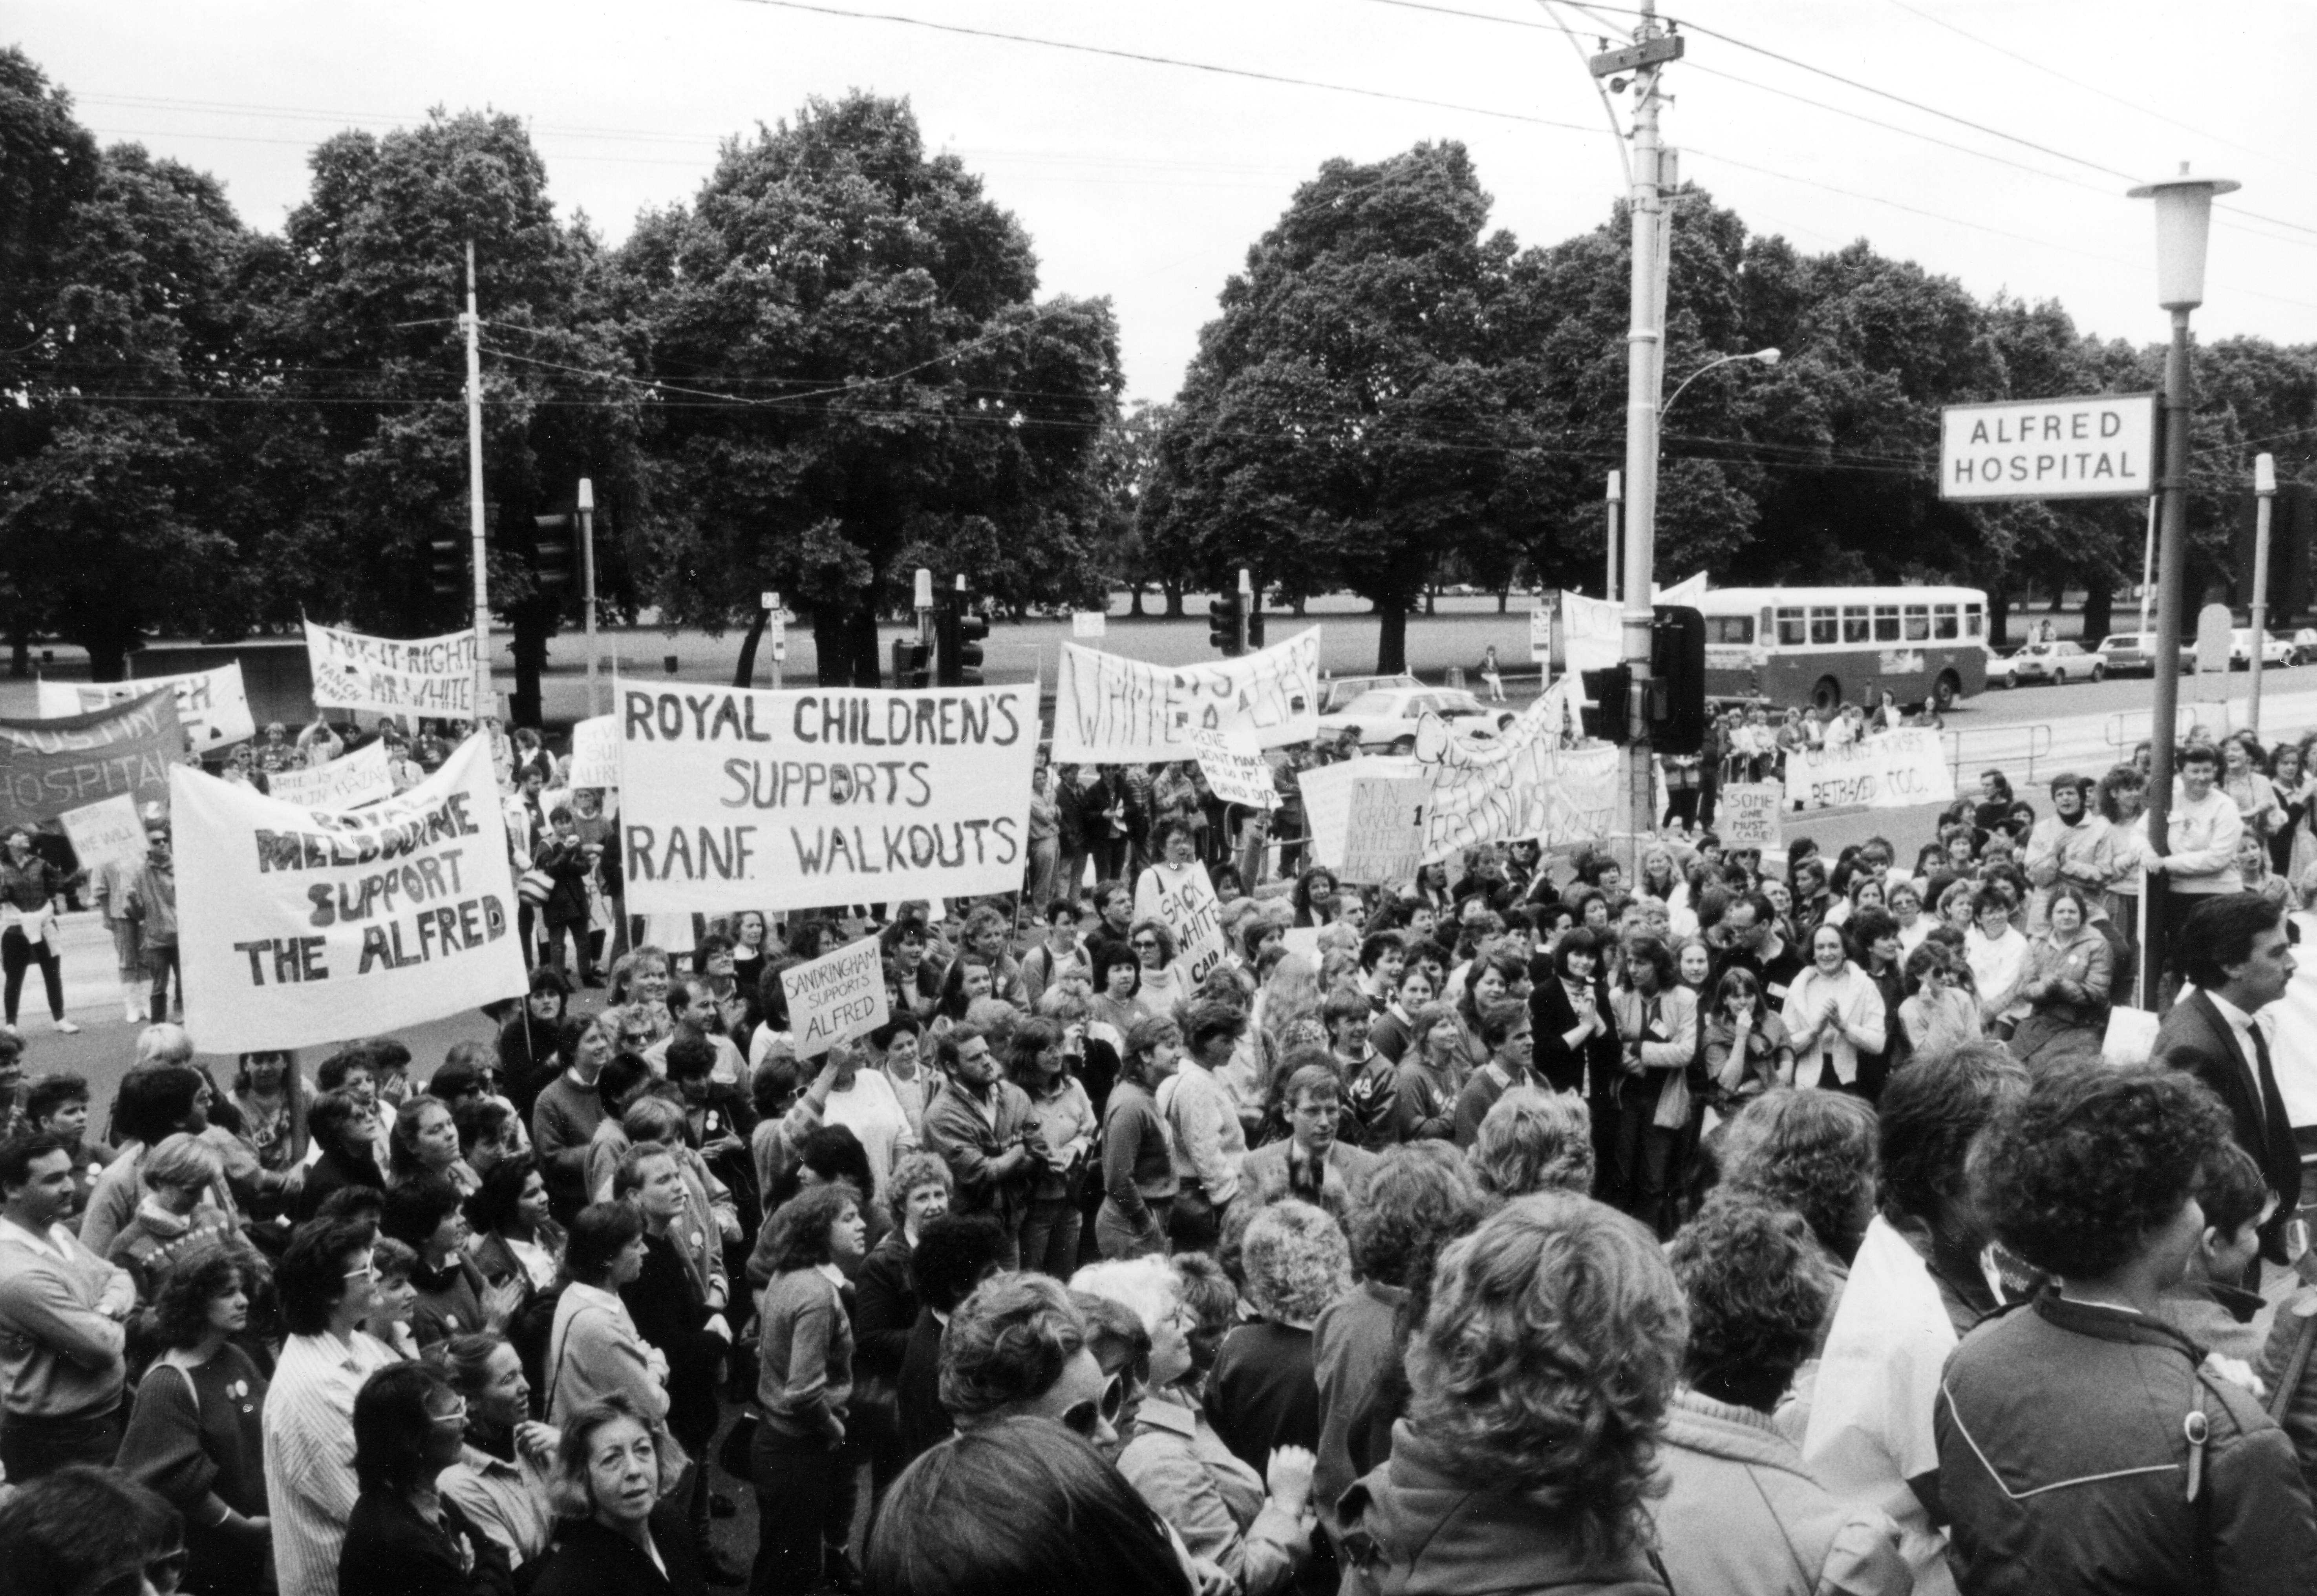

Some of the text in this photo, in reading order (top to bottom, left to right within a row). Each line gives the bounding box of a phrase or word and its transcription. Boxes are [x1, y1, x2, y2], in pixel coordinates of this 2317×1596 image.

[1970, 411, 2121, 444] ALFRED
[1955, 451, 2136, 483] HOSPITAL
[403, 676, 470, 711] WHITE
[626, 692, 1020, 745] ROYAL CHILDREN'S
[720, 758, 931, 809] SUPPORTS
[1731, 794, 1774, 809] SOME
[1811, 775, 1877, 806] BETRAYED
[1413, 804, 1423, 827] 1
[1733, 820, 1768, 831] MUST
[790, 816, 1018, 875] WALKOUTS
[308, 849, 464, 927] SUPPORT
[1161, 875, 1204, 926] SACK
[234, 895, 507, 986] THE ALFRED
[1177, 897, 1220, 955] WHITE
[785, 947, 877, 1000] SANDRINGHAM
[808, 975, 870, 1010] SUPPORTS
[806, 995, 874, 1042] ALFRED
